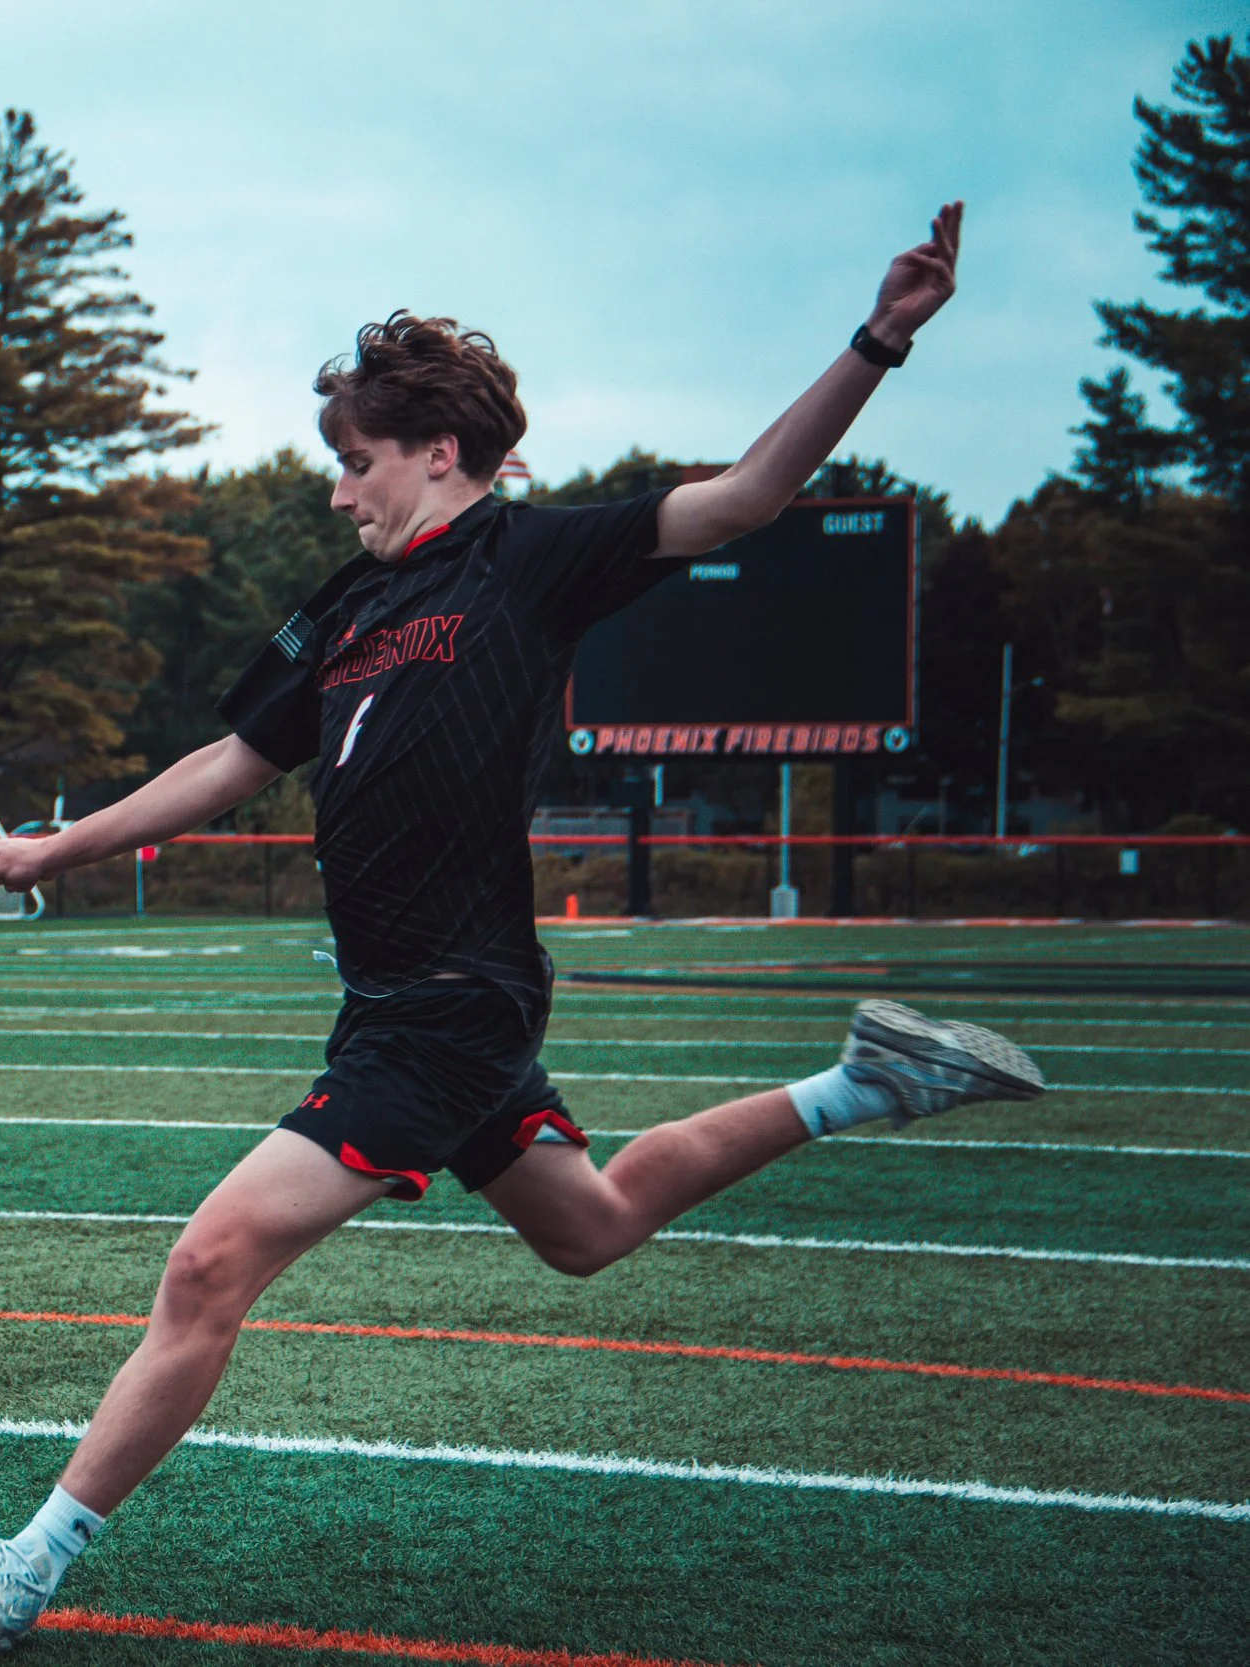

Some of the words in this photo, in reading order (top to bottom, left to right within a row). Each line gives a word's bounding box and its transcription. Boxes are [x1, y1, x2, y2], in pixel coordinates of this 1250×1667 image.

[823, 511, 886, 535] GUEST
[316, 615, 464, 689] HOENIX
[596, 728, 719, 753] PHOENIX
[725, 727, 881, 752] FIREBIRDS
